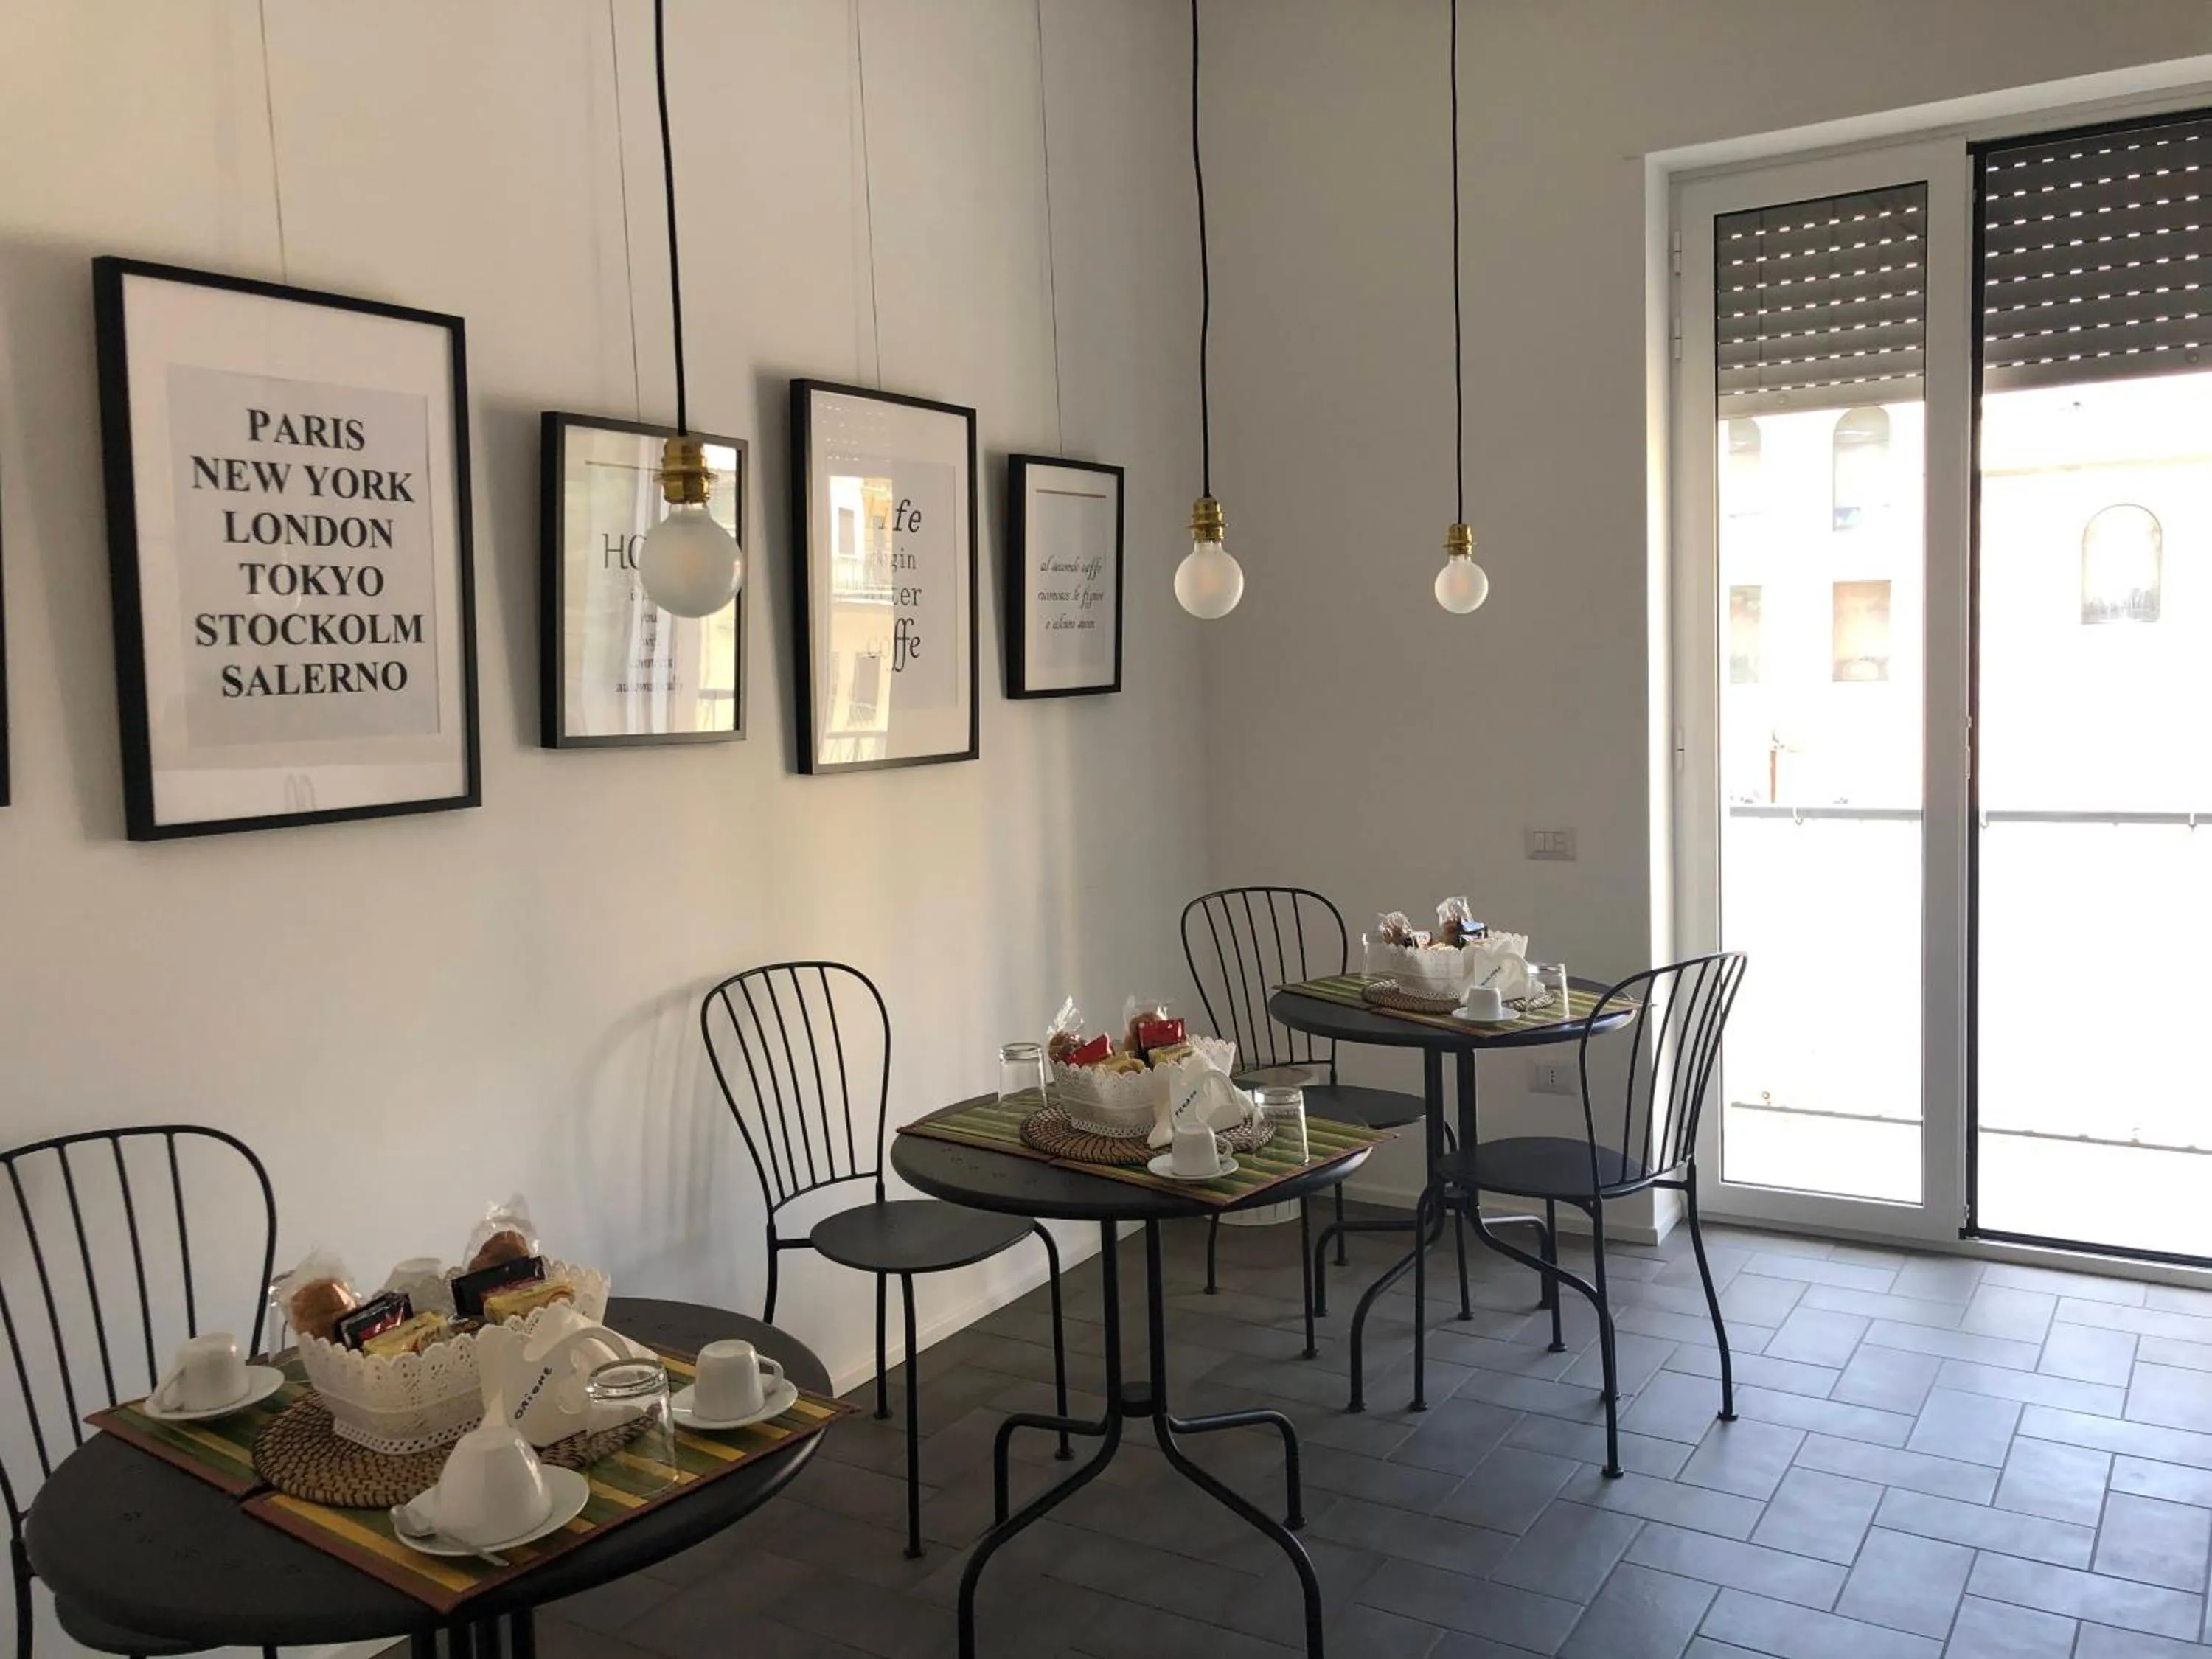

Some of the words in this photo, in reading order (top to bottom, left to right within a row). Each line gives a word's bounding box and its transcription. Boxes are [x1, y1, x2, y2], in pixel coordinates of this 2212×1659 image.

[246, 408, 365, 451] PARIS
[189, 454, 292, 495] NEW
[303, 465, 415, 503] YORK
[223, 510, 394, 549] LONDON
[239, 562, 385, 597] TOKYO
[195, 613, 425, 647] STOCKOLM
[221, 661, 408, 698] SALERNO
